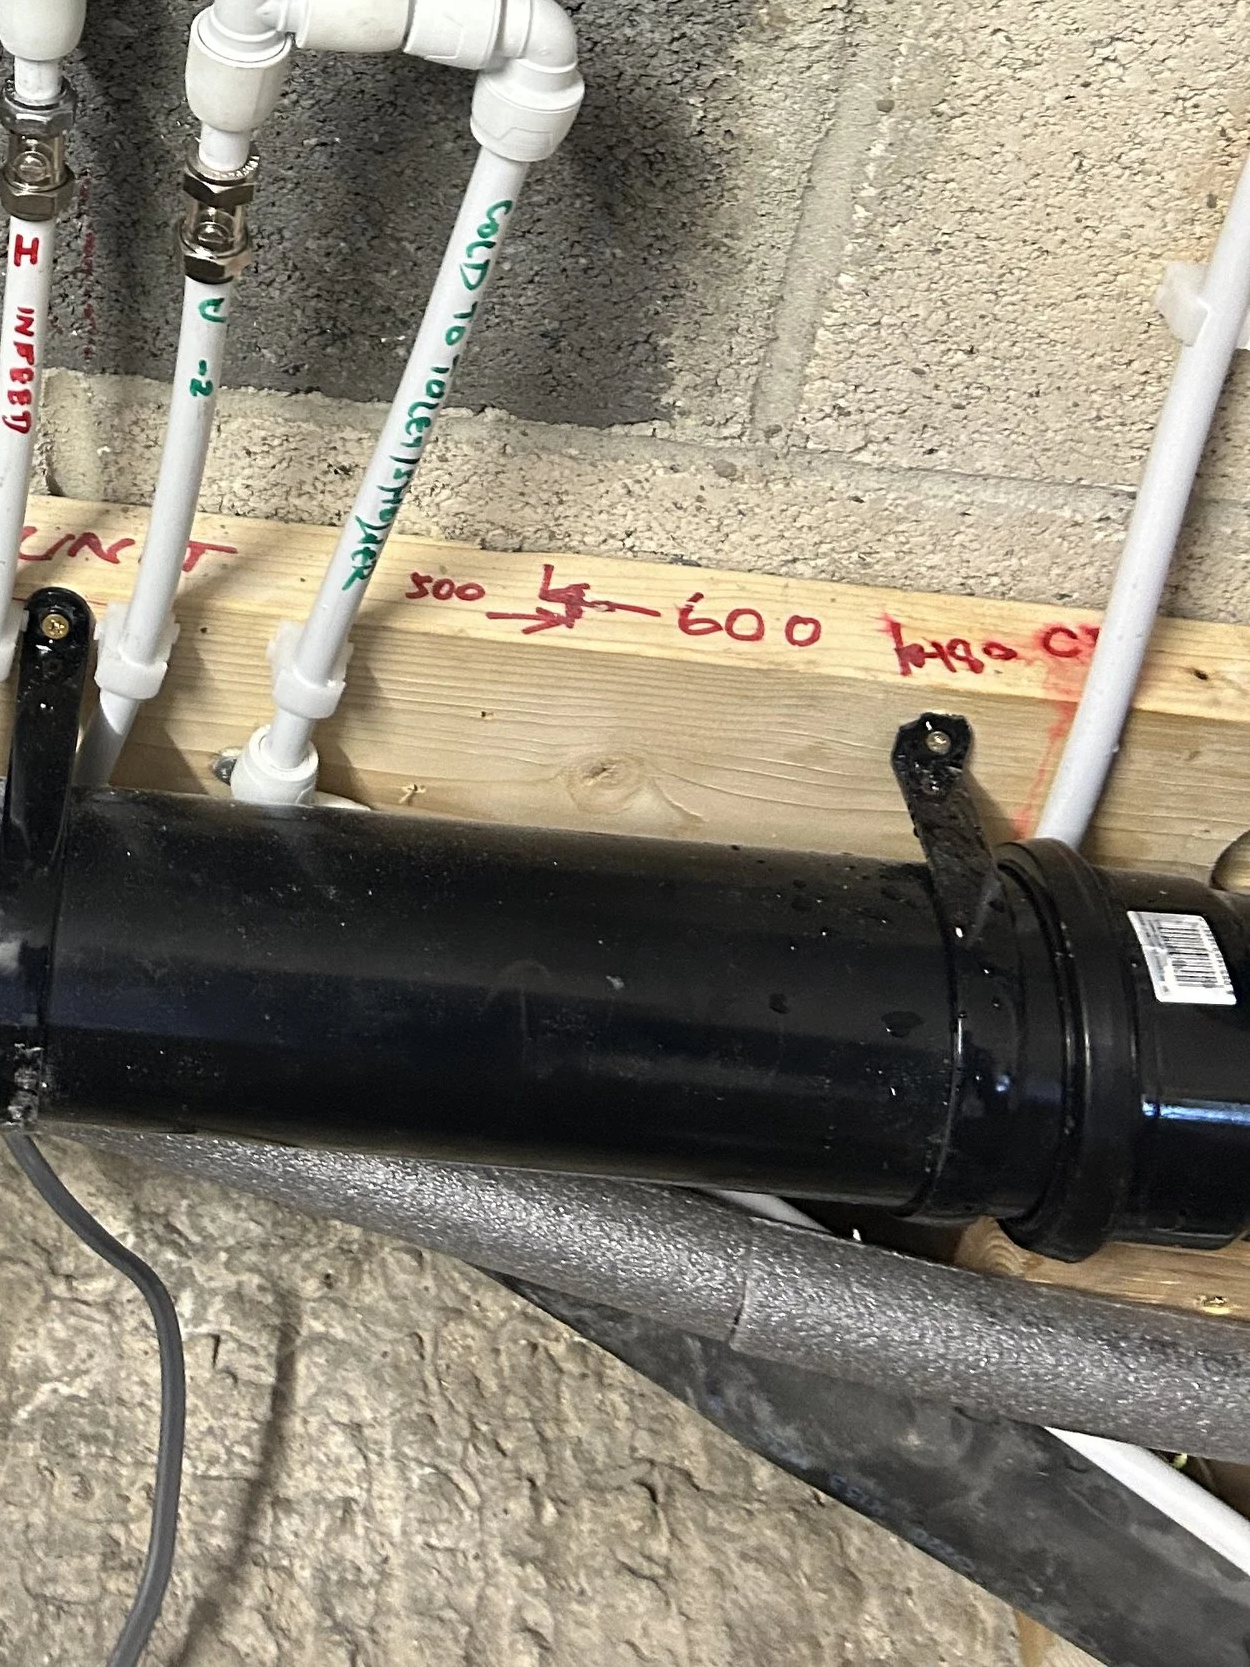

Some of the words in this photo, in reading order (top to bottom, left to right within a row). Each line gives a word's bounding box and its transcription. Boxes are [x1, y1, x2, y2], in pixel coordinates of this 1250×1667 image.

[459, 199, 513, 291] COLD
[445, 300, 478, 347] TO
[17, 524, 239, 573] UNT
[405, 571, 486, 602] 500
[676, 591, 822, 647] 600
